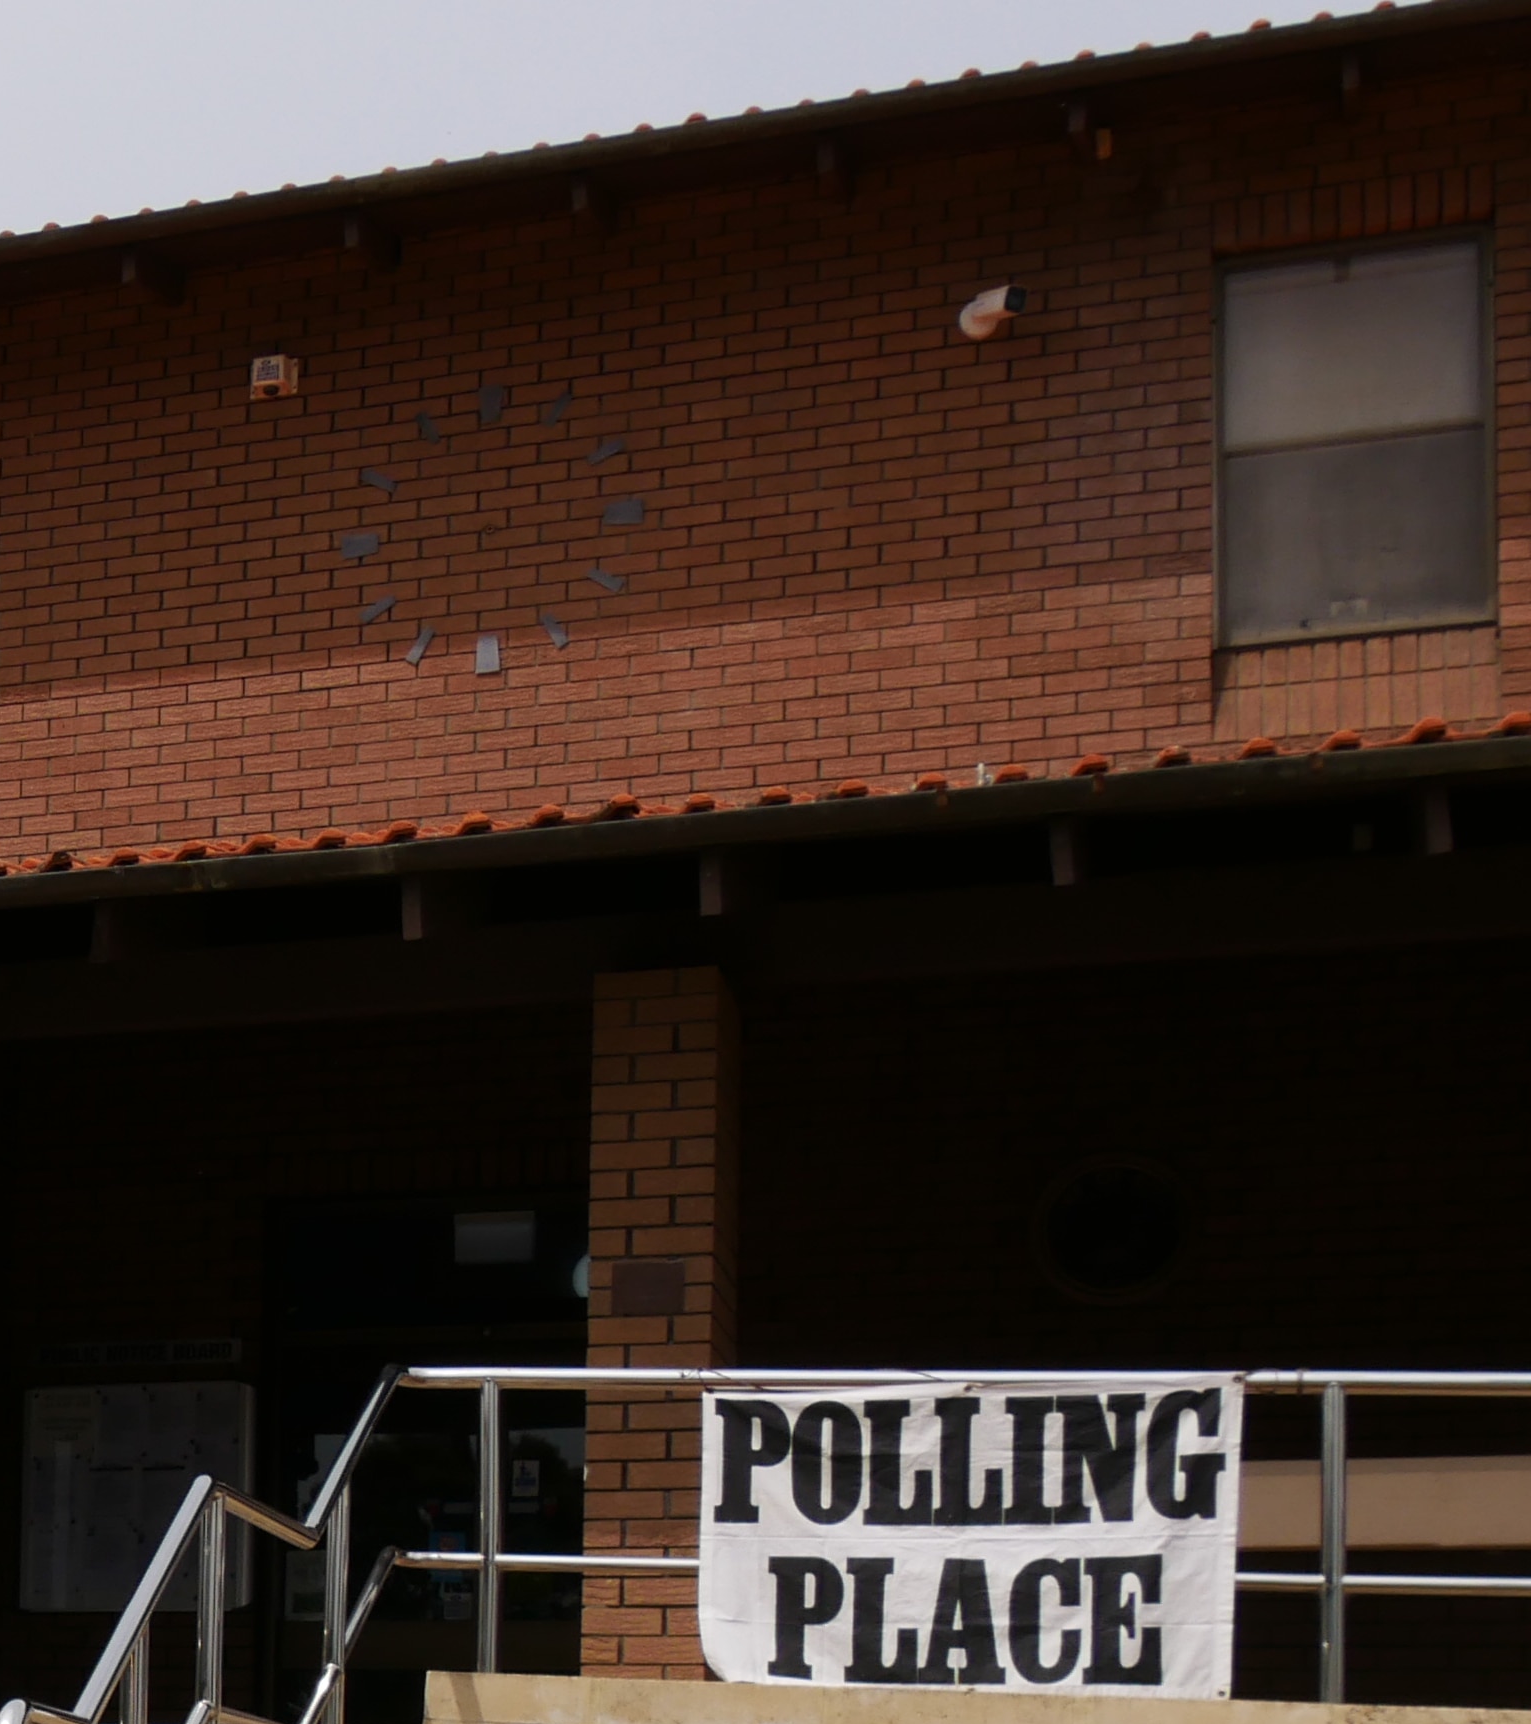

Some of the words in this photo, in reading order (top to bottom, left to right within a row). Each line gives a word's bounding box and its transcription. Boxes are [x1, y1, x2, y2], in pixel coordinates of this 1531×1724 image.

[107, 1343, 167, 1362] NOTICE
[174, 1341, 232, 1360] BOARD
[713, 1387, 1226, 1526] POLLING
[767, 1554, 1163, 1686] PLACE
